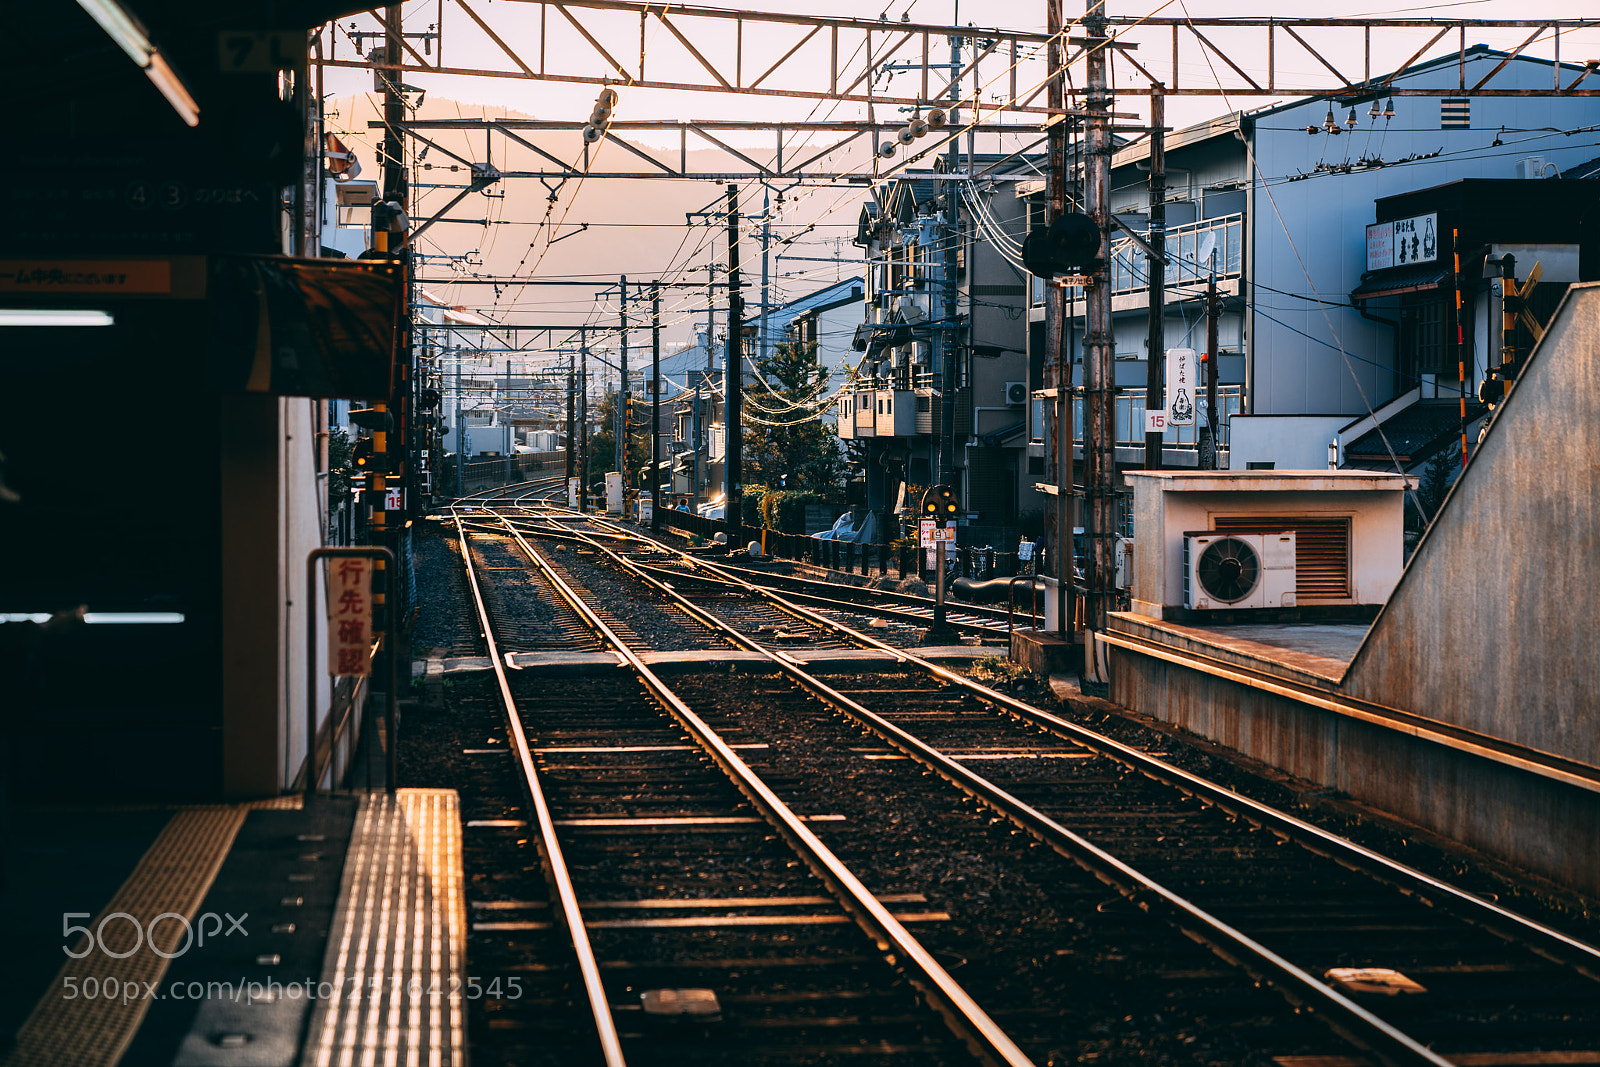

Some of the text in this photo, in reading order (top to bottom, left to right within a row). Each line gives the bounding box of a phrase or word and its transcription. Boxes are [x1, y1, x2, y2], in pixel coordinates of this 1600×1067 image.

[1150, 415, 1165, 428] 15
[337, 559, 365, 674] 行先確認
